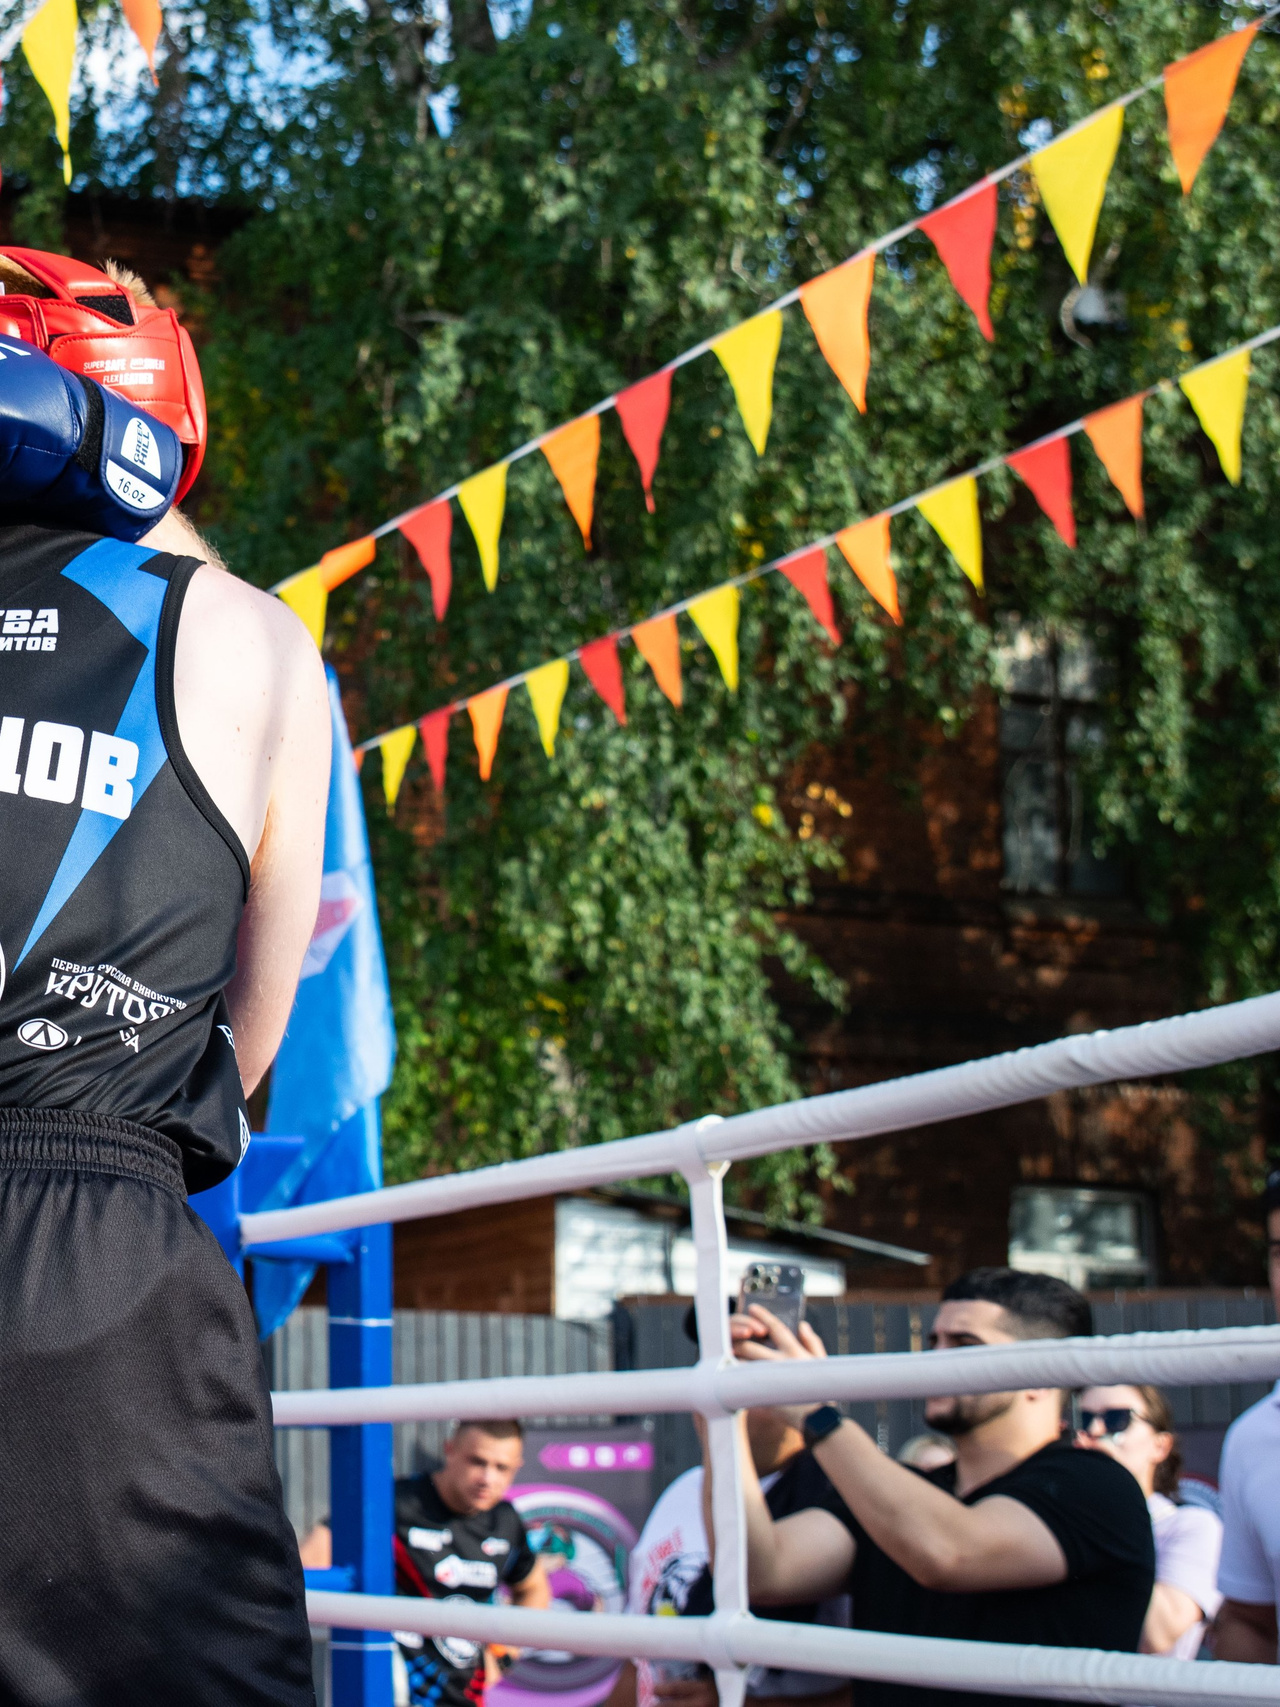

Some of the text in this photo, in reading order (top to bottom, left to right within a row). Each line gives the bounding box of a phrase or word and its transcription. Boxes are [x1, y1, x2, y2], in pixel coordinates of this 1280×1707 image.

[133, 420, 143, 463] GREEN
[139, 431, 151, 466] HILL
[51, 957, 95, 974] ПЕРВАЯ
[44, 971, 176, 1025] КРУТОЯ
